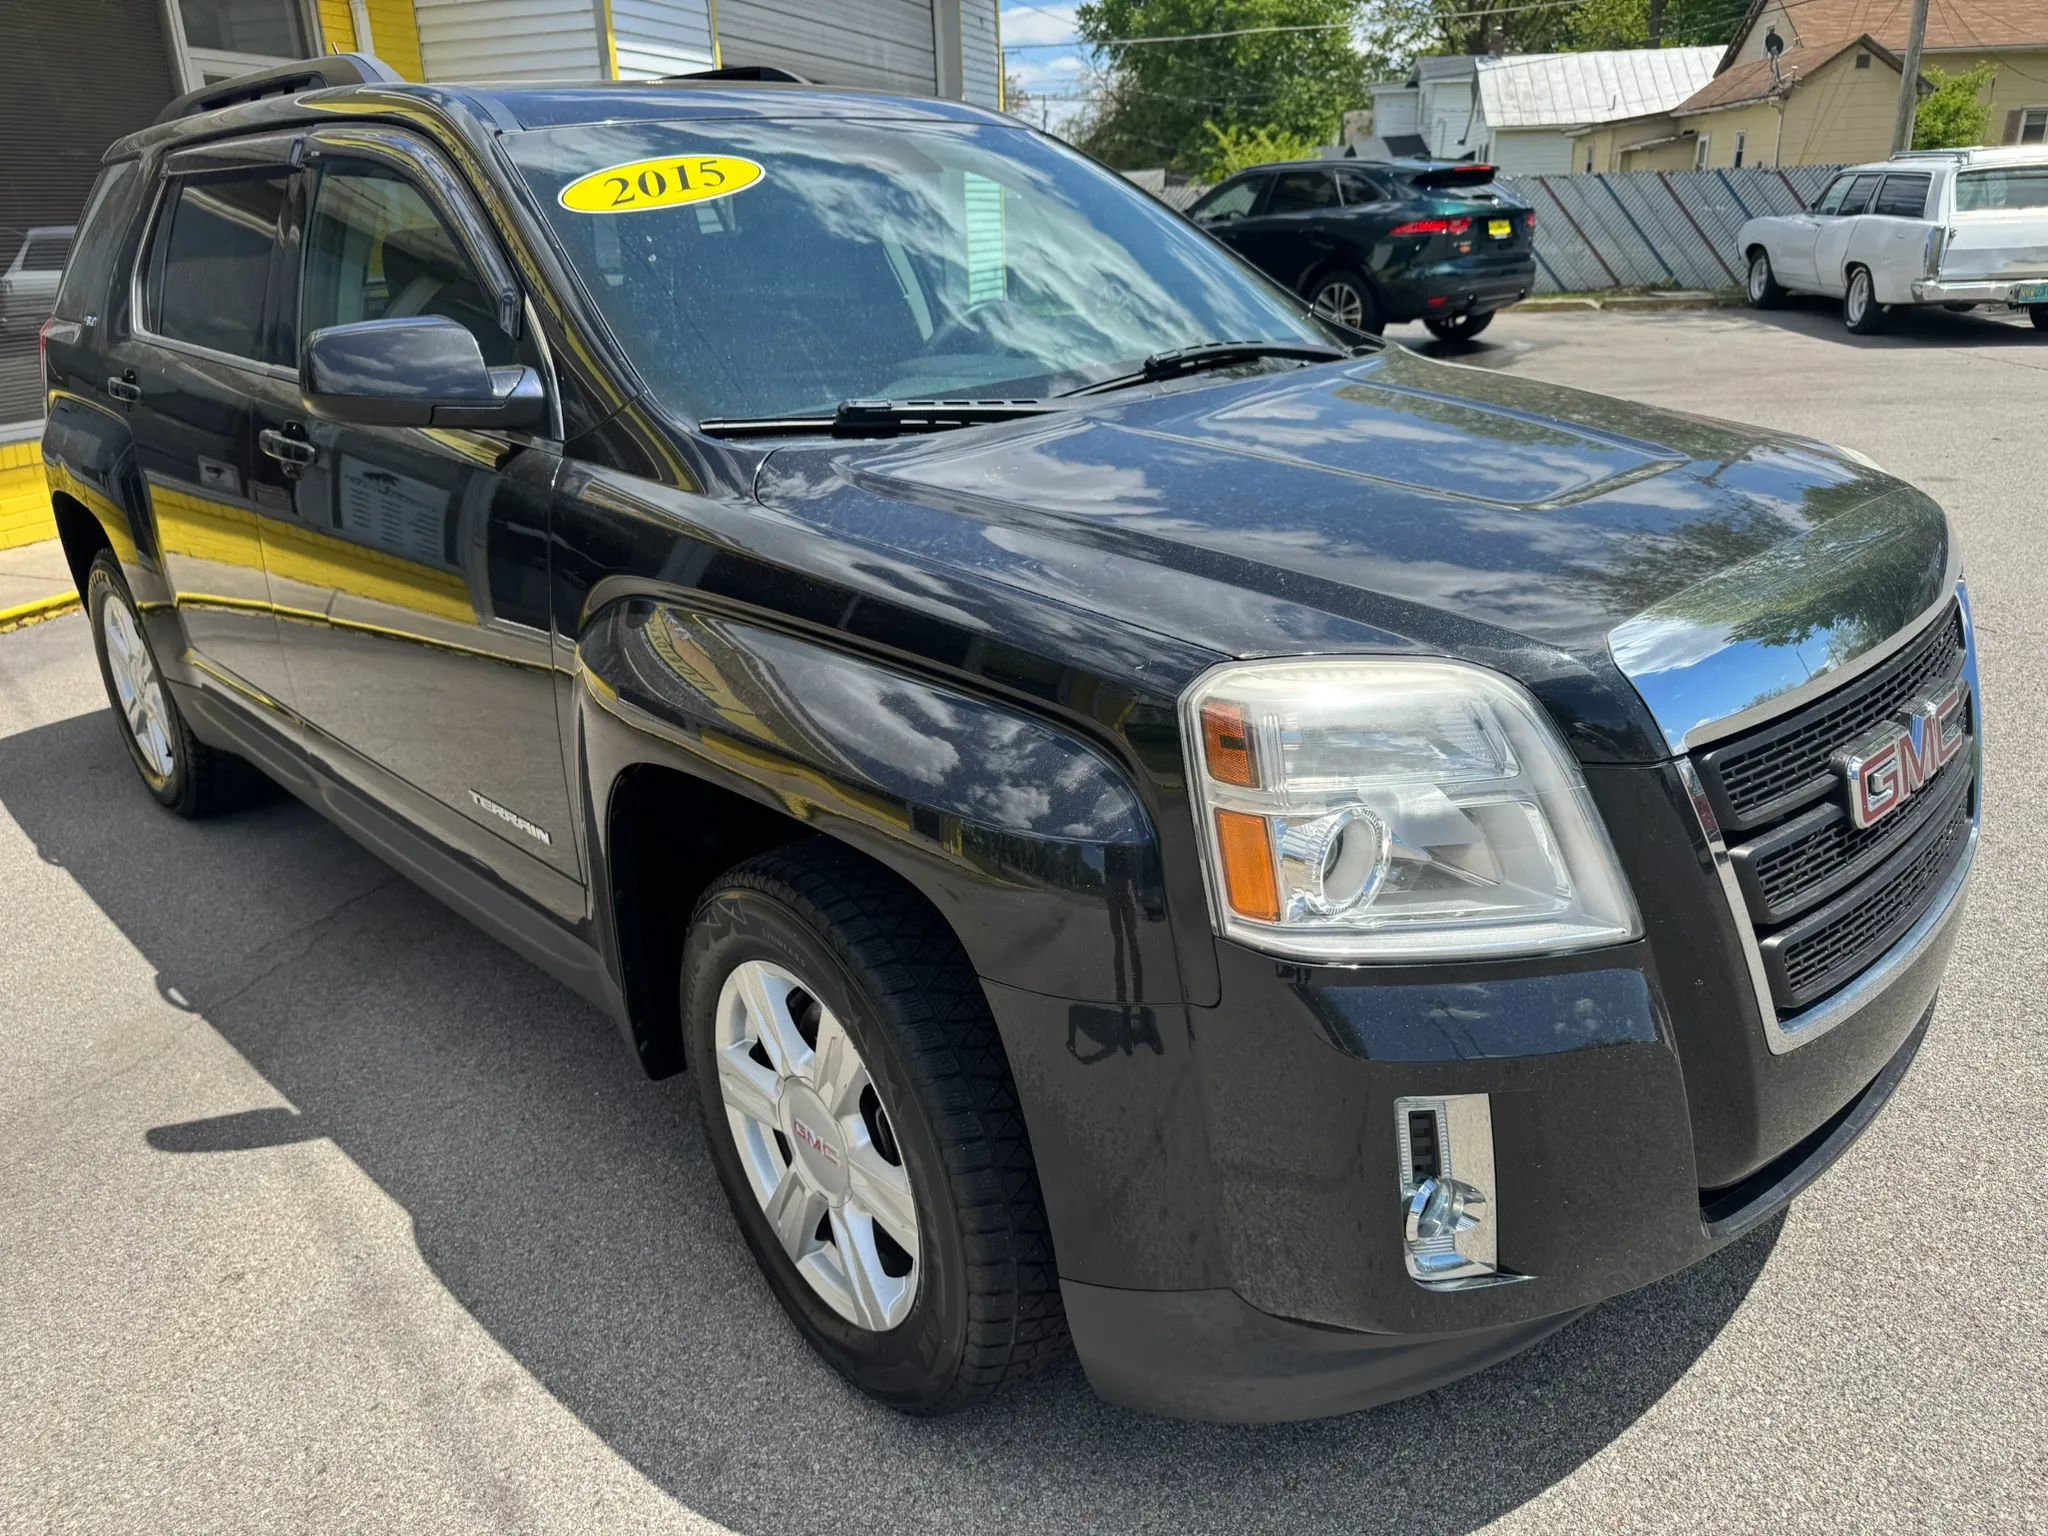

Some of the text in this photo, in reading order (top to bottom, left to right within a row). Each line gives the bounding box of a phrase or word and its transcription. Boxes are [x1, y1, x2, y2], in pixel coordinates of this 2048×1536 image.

[603, 160, 726, 207] 2015
[1849, 686, 1964, 830] GMC
[468, 788, 552, 846] TERRAIN
[792, 1118, 840, 1168] GMC
